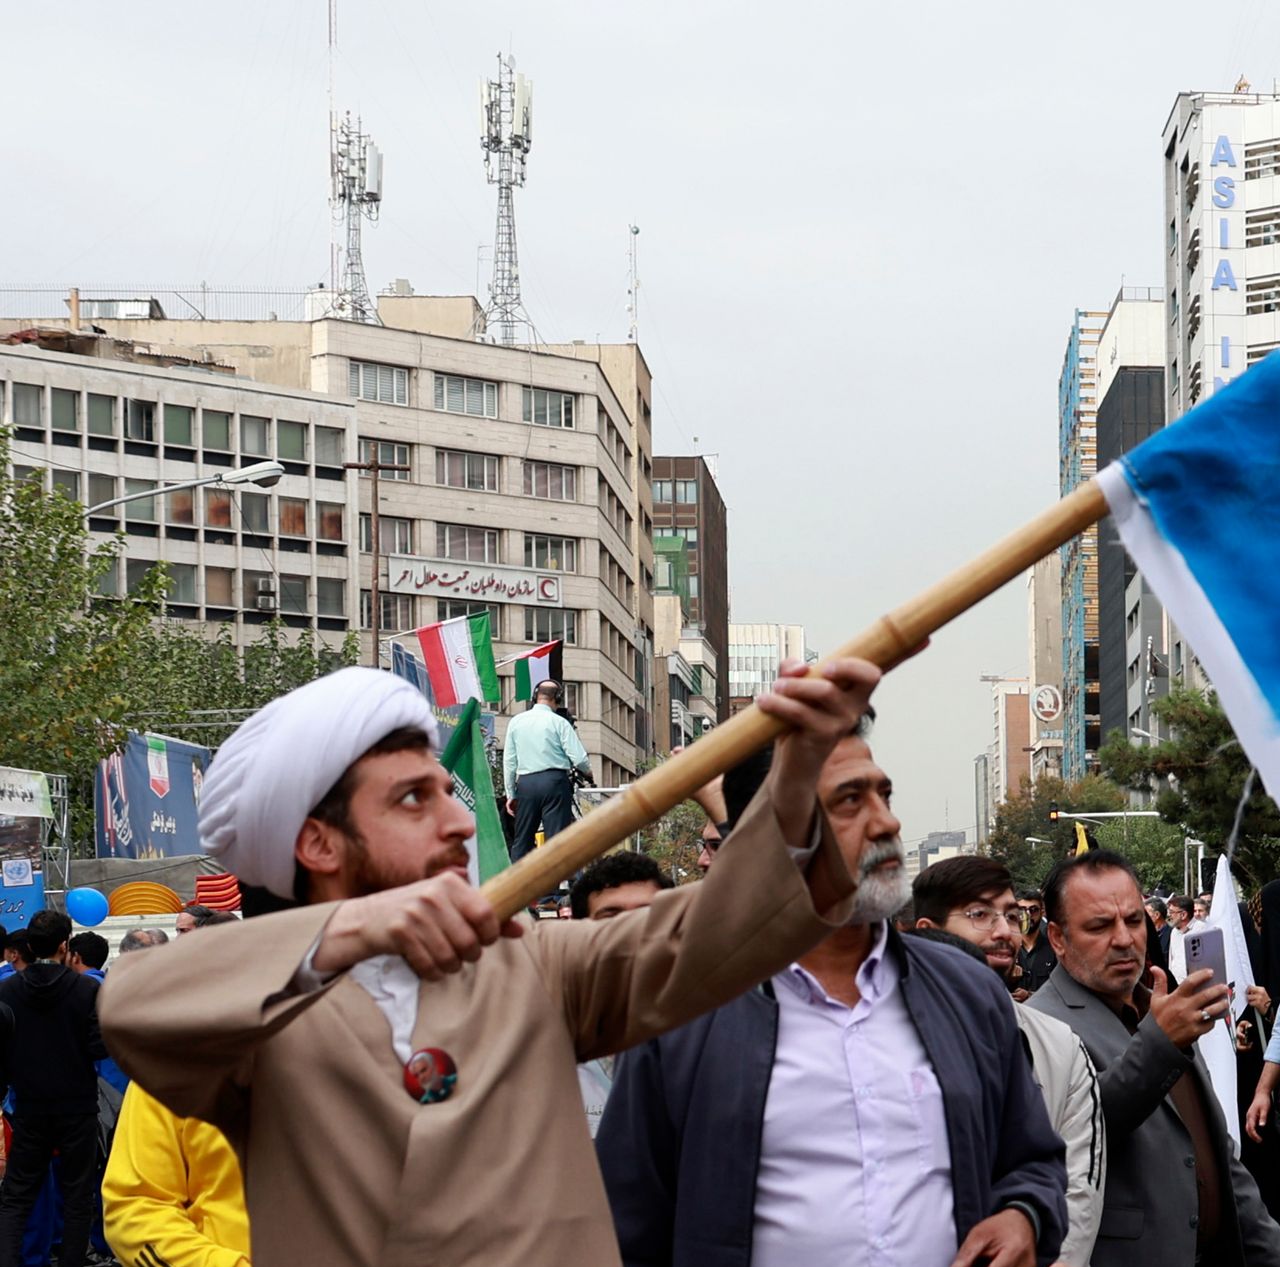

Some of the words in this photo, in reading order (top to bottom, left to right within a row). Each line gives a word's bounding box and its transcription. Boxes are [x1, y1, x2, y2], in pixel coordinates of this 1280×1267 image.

[1210, 135, 1238, 291] ASIA
[394, 569, 414, 587] احمر
[415, 565, 438, 589] هلال
